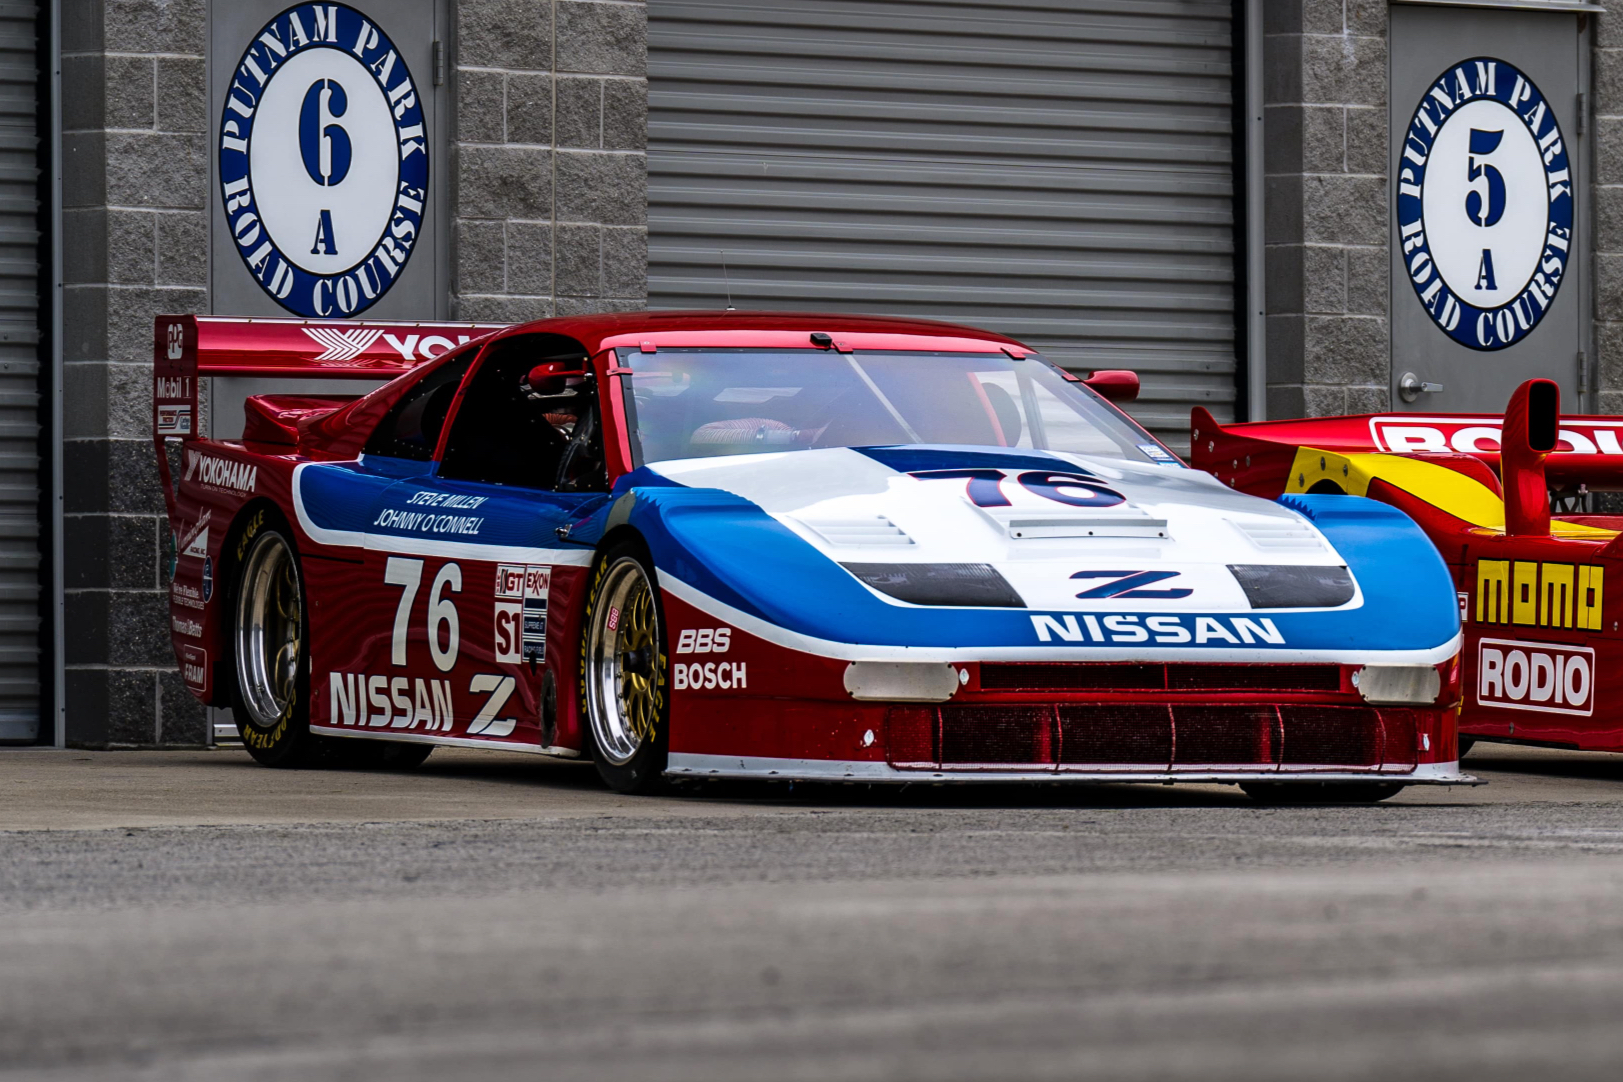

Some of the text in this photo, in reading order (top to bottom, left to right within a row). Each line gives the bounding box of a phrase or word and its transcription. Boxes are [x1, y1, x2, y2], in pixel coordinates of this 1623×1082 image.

[222, 4, 426, 161] PUTNAM PARK
[299, 78, 352, 187] 6
[1399, 61, 1571, 203] PUTNAM PARK
[1465, 127, 1506, 227] 5
[223, 174, 425, 317] ROAD COURSE
[310, 209, 338, 255] A
[1400, 217, 1570, 347] ROAD COURSE
[1474, 248, 1498, 290] A
[168, 324, 183, 356] PPG
[157, 377, 181, 398] Mobil
[199, 457, 257, 493] YOKOHAMA
[906, 468, 1127, 508] 76
[406, 491, 489, 510] STEVE MILLEN
[236, 509, 265, 562] EAGLE
[373, 508, 484, 535] JOHNNY O'CONNELL
[506, 571, 523, 592] GT
[526, 570, 550, 596] EXXON
[384, 555, 463, 673] 76
[496, 609, 521, 656] S1
[608, 607, 620, 630] BBS
[1029, 614, 1286, 644] NISSAN
[676, 627, 731, 654] BBS
[184, 663, 204, 684] FRAM
[674, 661, 747, 690] BOSCH
[1481, 648, 1591, 707] RODIO
[329, 671, 454, 732] NISSAN
